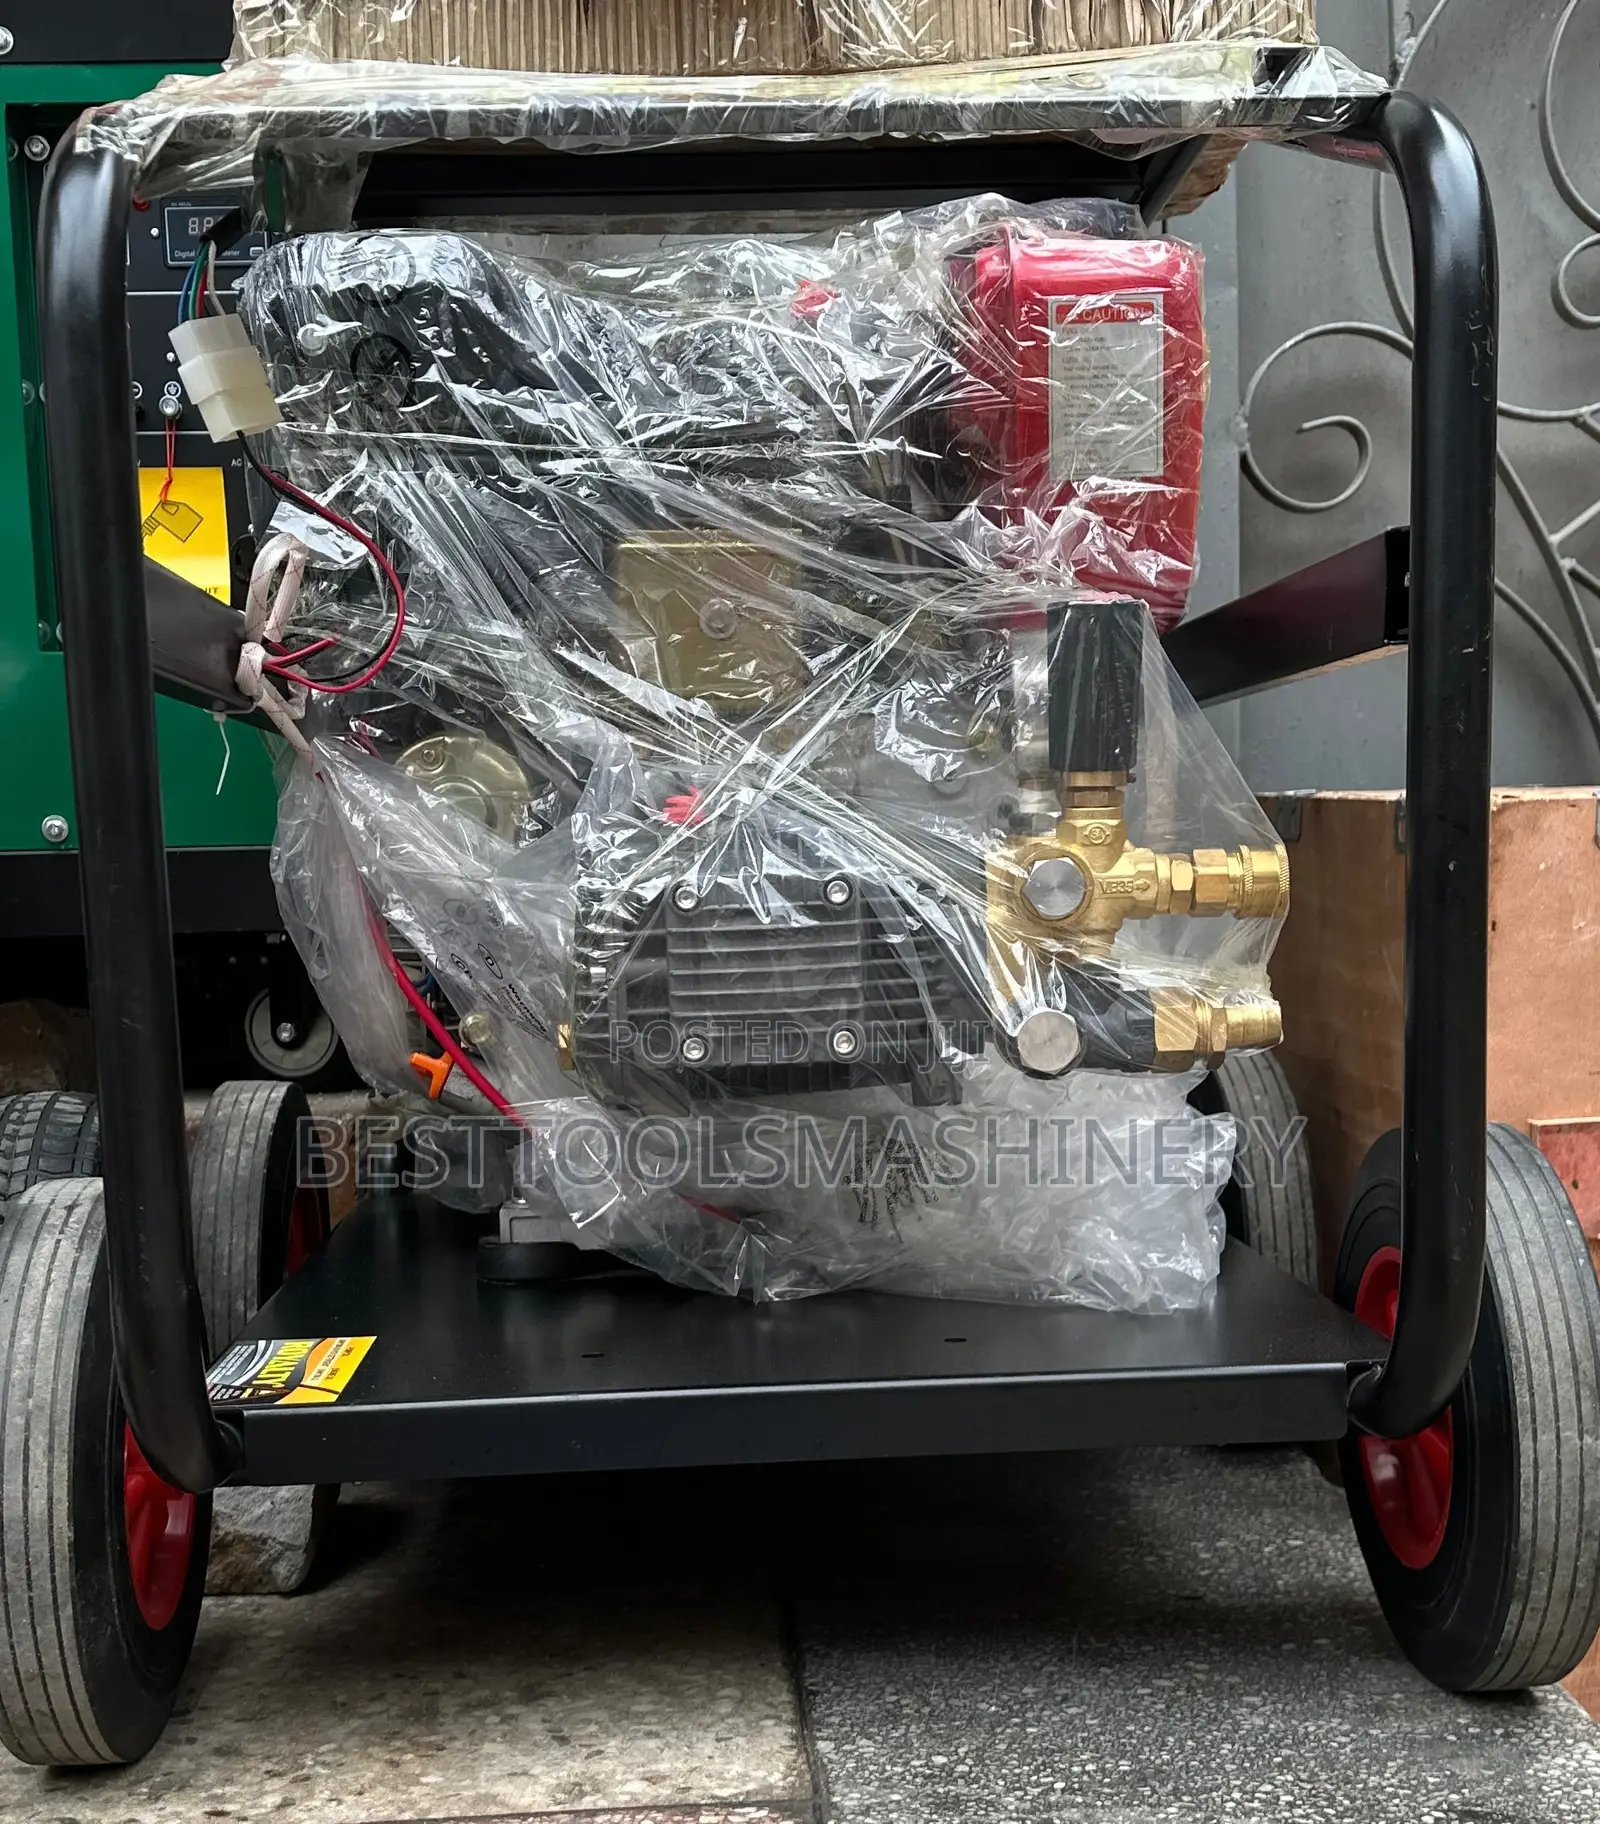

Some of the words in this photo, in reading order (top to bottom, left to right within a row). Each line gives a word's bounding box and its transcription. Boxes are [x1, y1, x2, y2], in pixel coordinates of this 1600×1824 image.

[174, 250, 196, 259] Digital
[1082, 307, 1145, 321] CAUTION
[230, 458, 242, 467] AC
